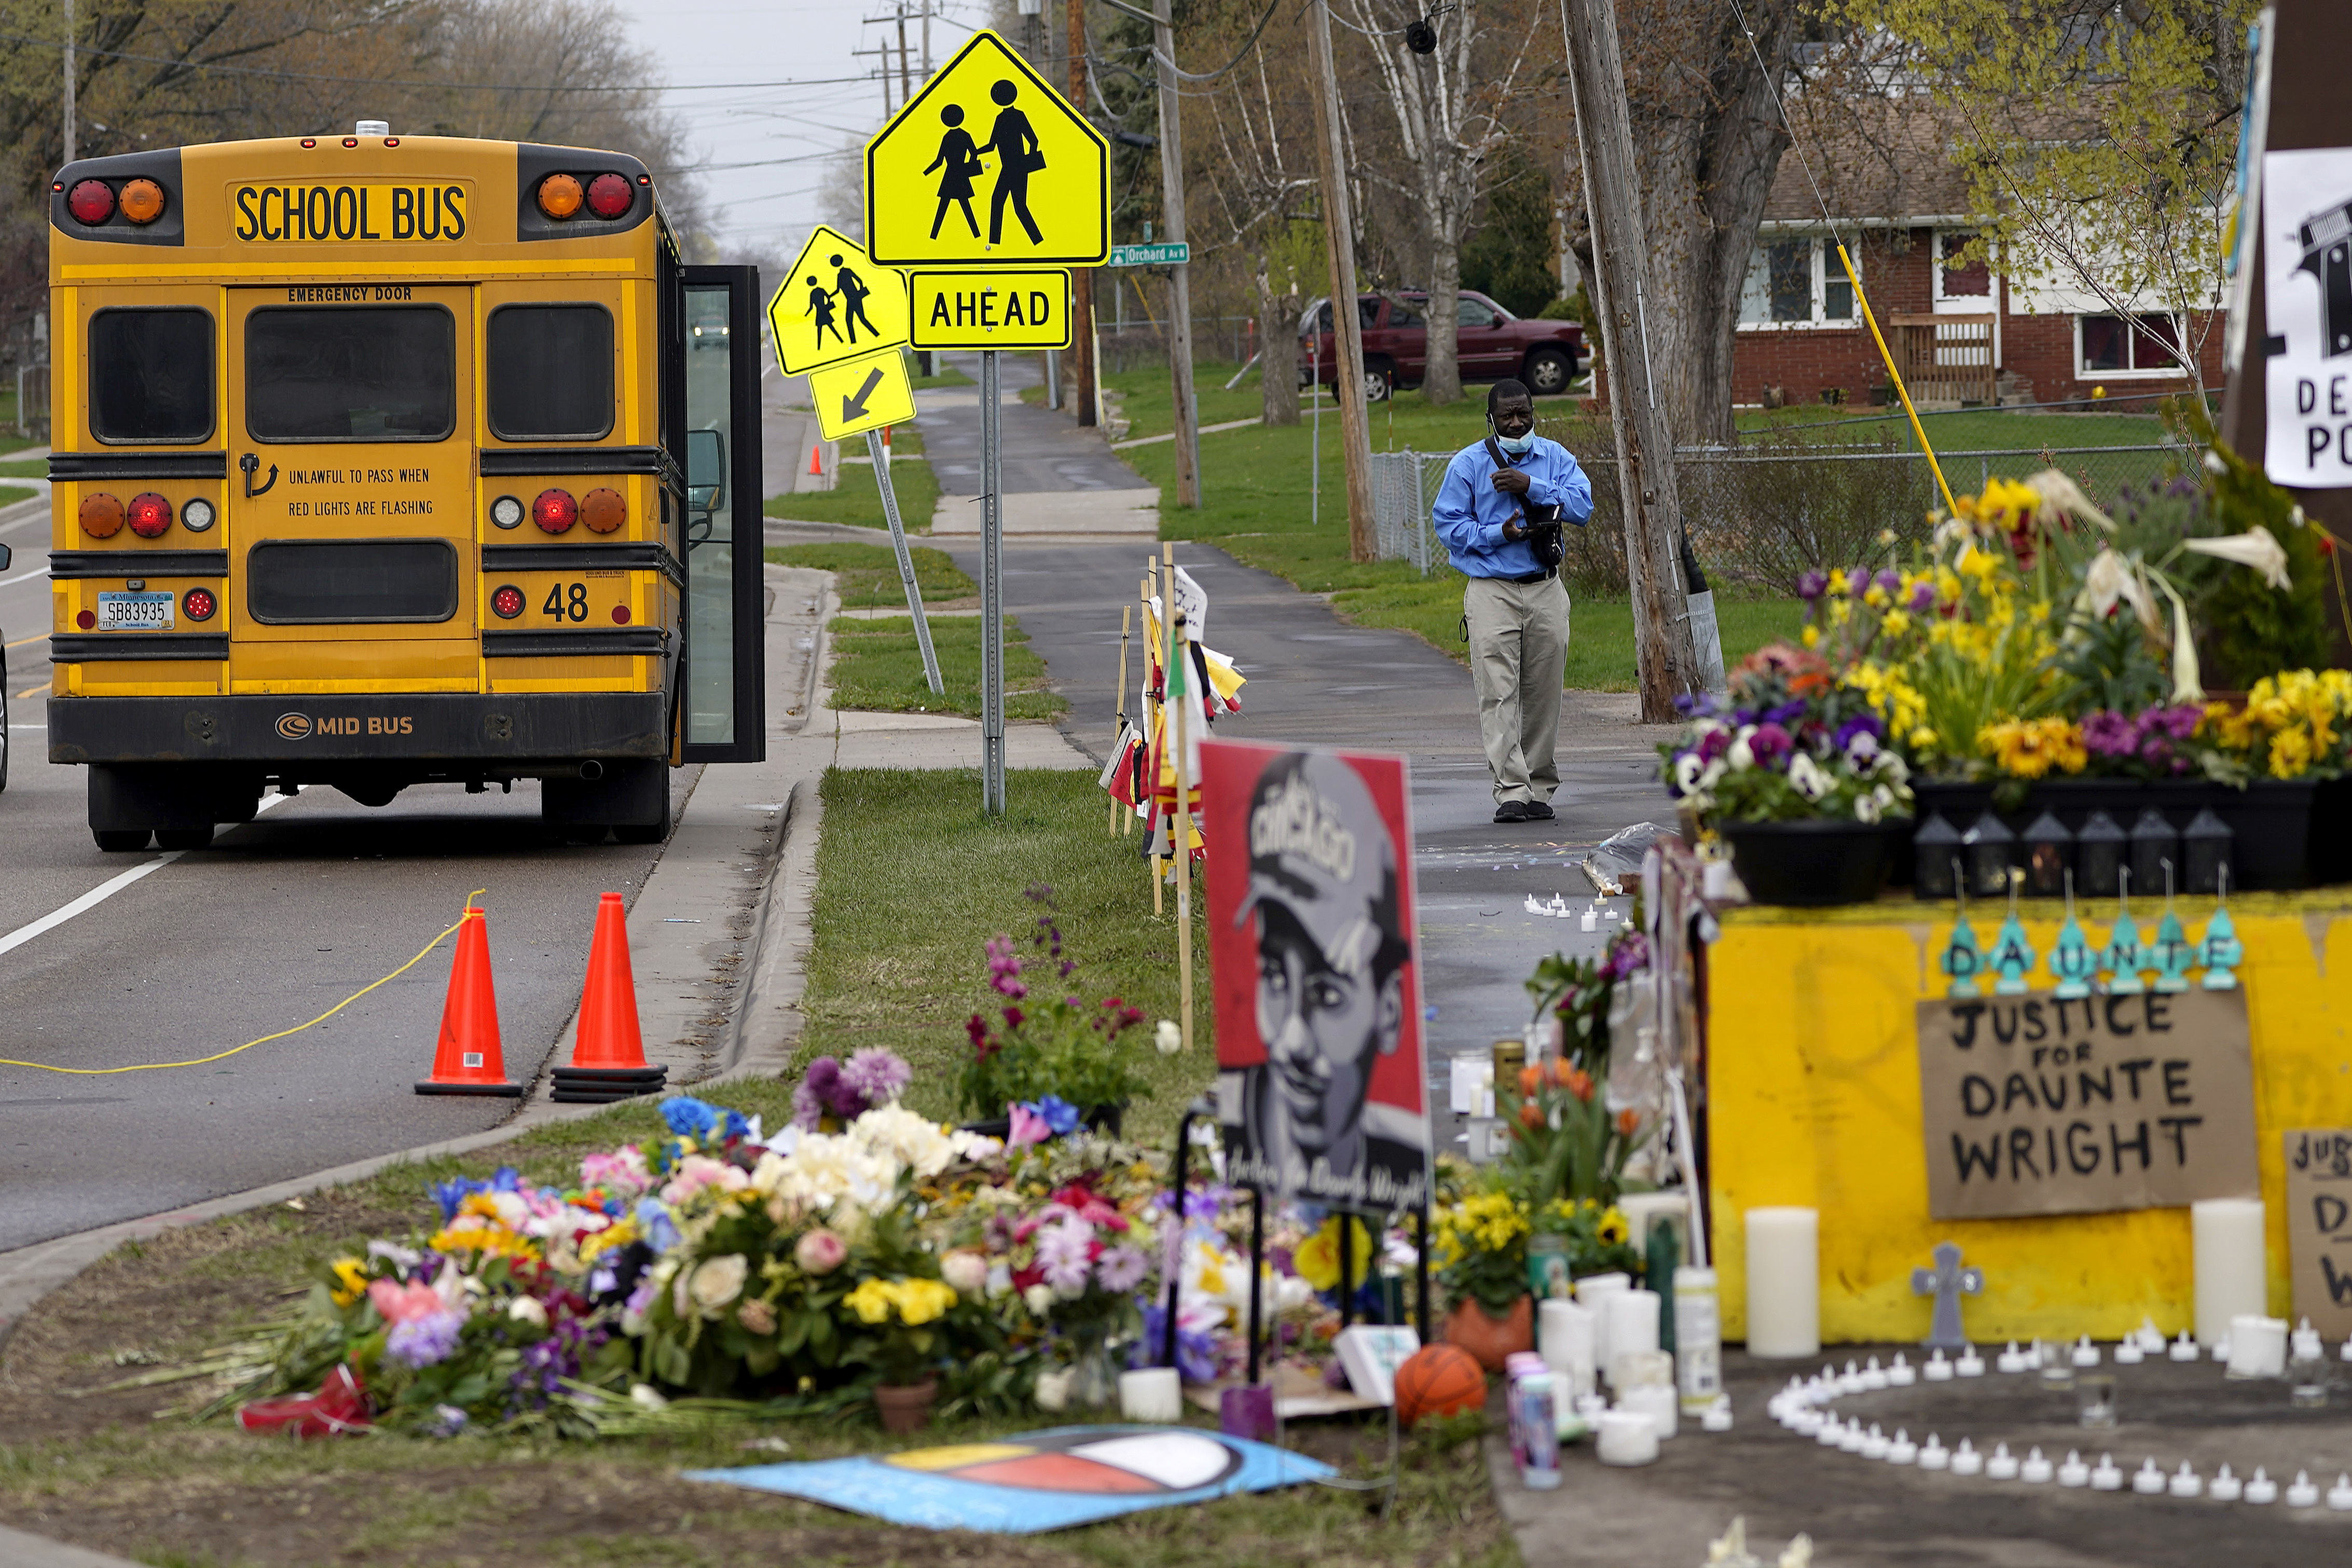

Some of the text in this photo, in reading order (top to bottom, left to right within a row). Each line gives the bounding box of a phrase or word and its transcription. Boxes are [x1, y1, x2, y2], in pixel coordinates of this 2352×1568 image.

[237, 185, 466, 241] SCHOOL BUS
[1129, 247, 1185, 262] Orchard Av N
[288, 286, 412, 302] EMERGENCY DOOR
[930, 291, 1050, 327] AHEAD
[289, 468, 429, 484] UNLAWFUL TO PASS WHEN
[288, 500, 433, 516] RED LIGHTS ARE FLASHING
[108, 602, 165, 621] SB83935
[542, 583, 589, 623] 48
[317, 717, 413, 735] MID BUS
[1951, 992, 2175, 1049] JUSTICE
[2032, 1042, 2093, 1069] FOR
[1961, 1060, 2192, 1119] DAUNTE
[1951, 1116, 2203, 1184] WRIGHT
